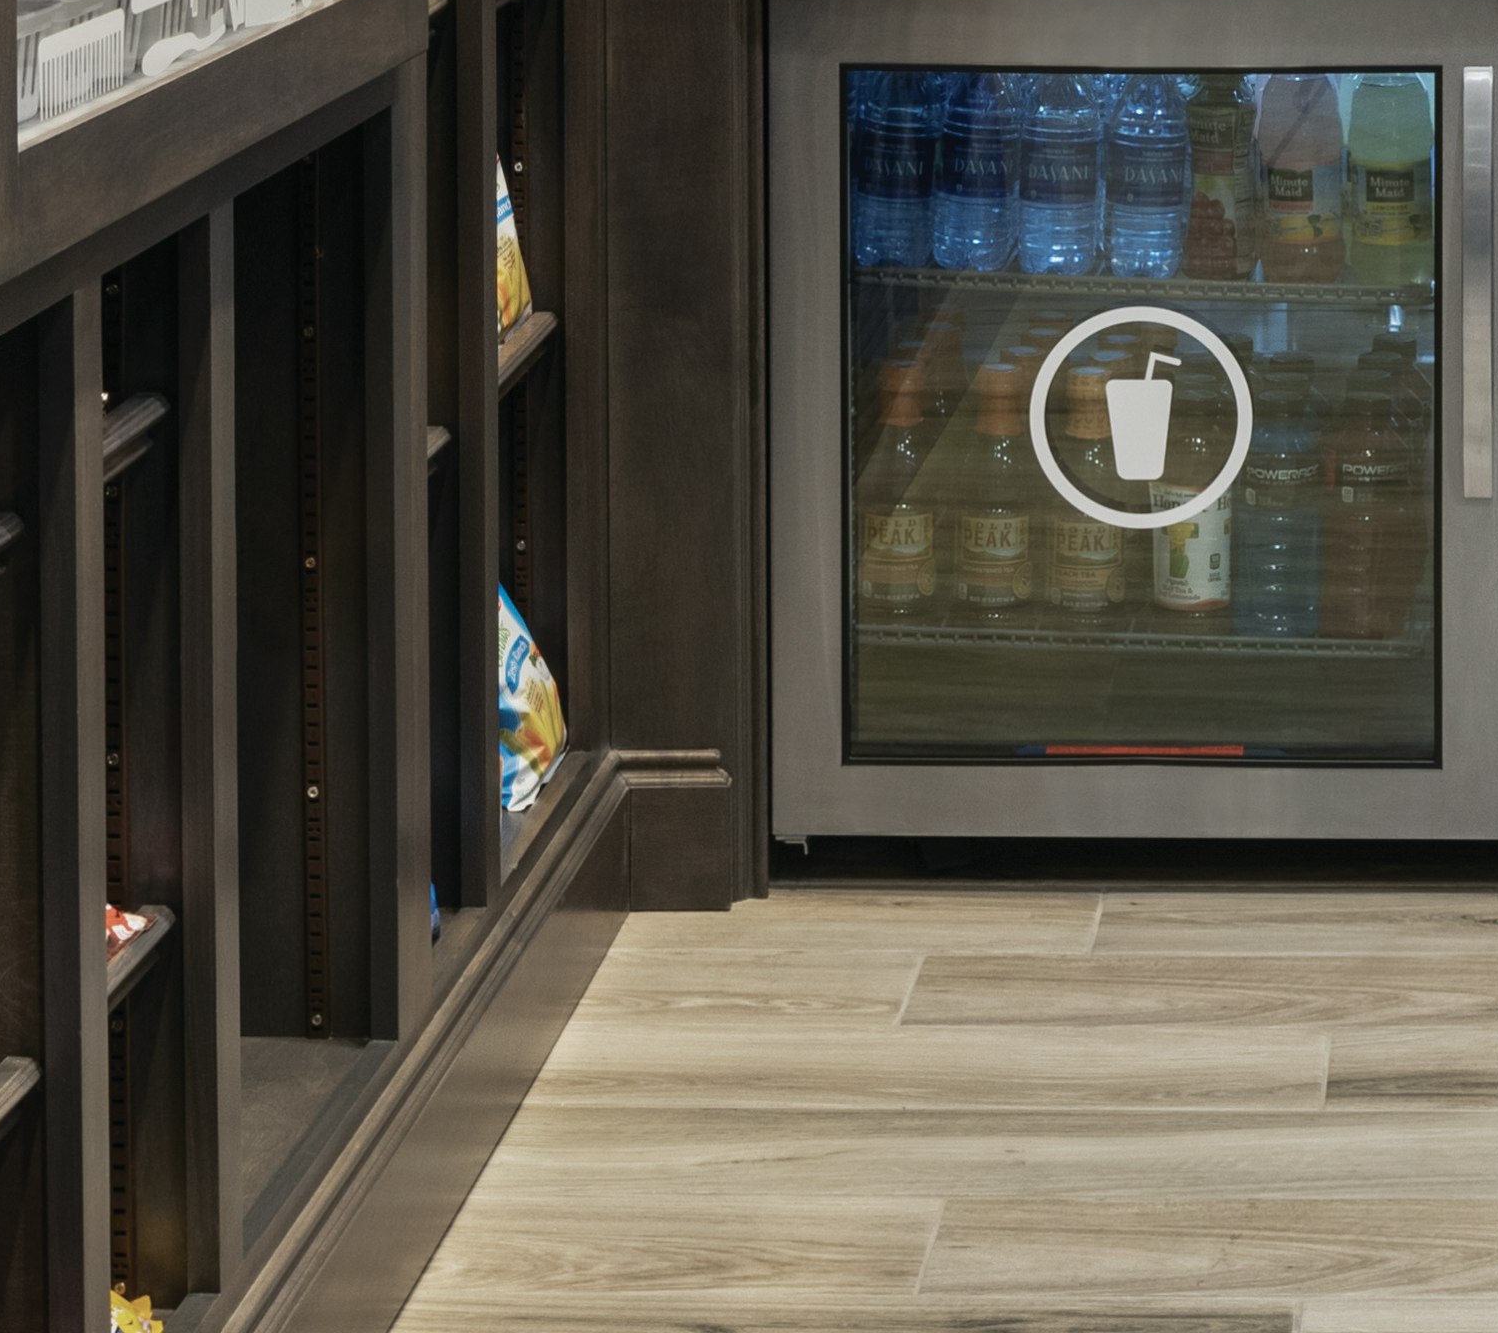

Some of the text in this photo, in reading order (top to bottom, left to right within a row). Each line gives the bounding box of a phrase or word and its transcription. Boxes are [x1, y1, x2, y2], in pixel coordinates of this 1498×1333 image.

[864, 156, 924, 177] DASANI
[953, 158, 1014, 176] DASANI
[1028, 164, 1089, 181] DASANI
[1124, 164, 1184, 183] DASANI
[1270, 175, 1309, 188] Minute
[1370, 176, 1410, 187] Minute
[1275, 187, 1303, 197] Maid
[1375, 187, 1405, 198] Maid
[867, 527, 916, 547] PEAK
[964, 530, 1011, 549] PEAK
[1056, 534, 1105, 553] PEAK
